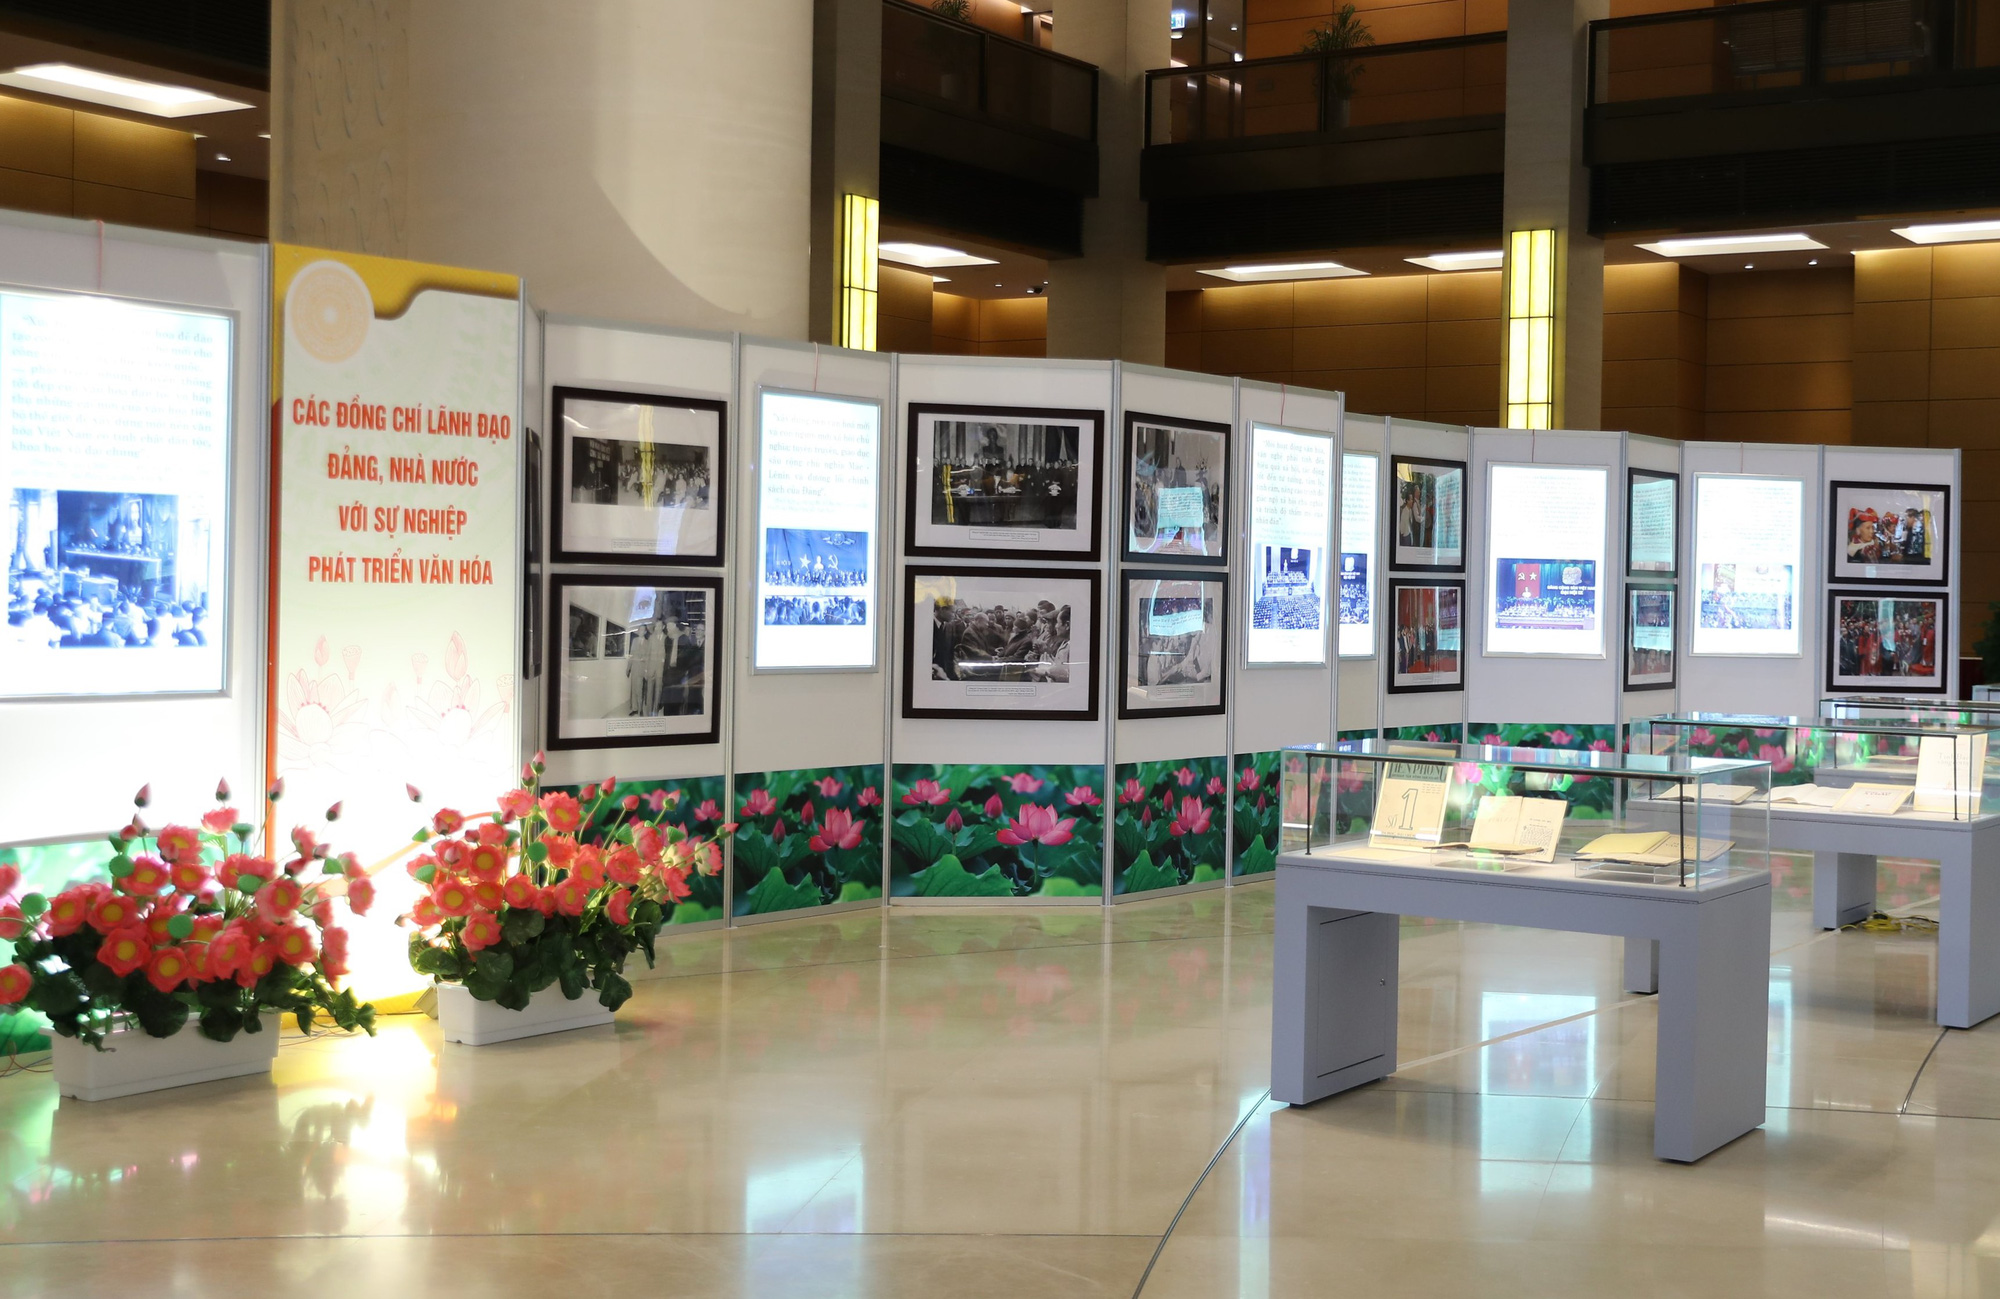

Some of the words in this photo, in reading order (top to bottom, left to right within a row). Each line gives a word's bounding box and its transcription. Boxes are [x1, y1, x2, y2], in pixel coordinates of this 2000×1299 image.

[293, 394, 330, 427] CÁC
[337, 395, 387, 431] ĐỒNG
[392, 403, 422, 433] CHÍ
[428, 406, 472, 437] LÃNH
[478, 413, 511, 444] ĐẠO
[327, 446, 383, 485] ĐẢNG,
[390, 453, 426, 484] NHÀ
[432, 456, 479, 486] NƯỚC
[339, 501, 368, 532] VỚI
[374, 505, 399, 538] SỰ
[404, 505, 467, 540] NGHIỆP
[309, 552, 356, 582] PHÁT
[362, 548, 413, 583] TRIỂN
[419, 554, 454, 584] VĂN
[460, 555, 493, 585] HÓA
[1399, 788, 1418, 830] 1
